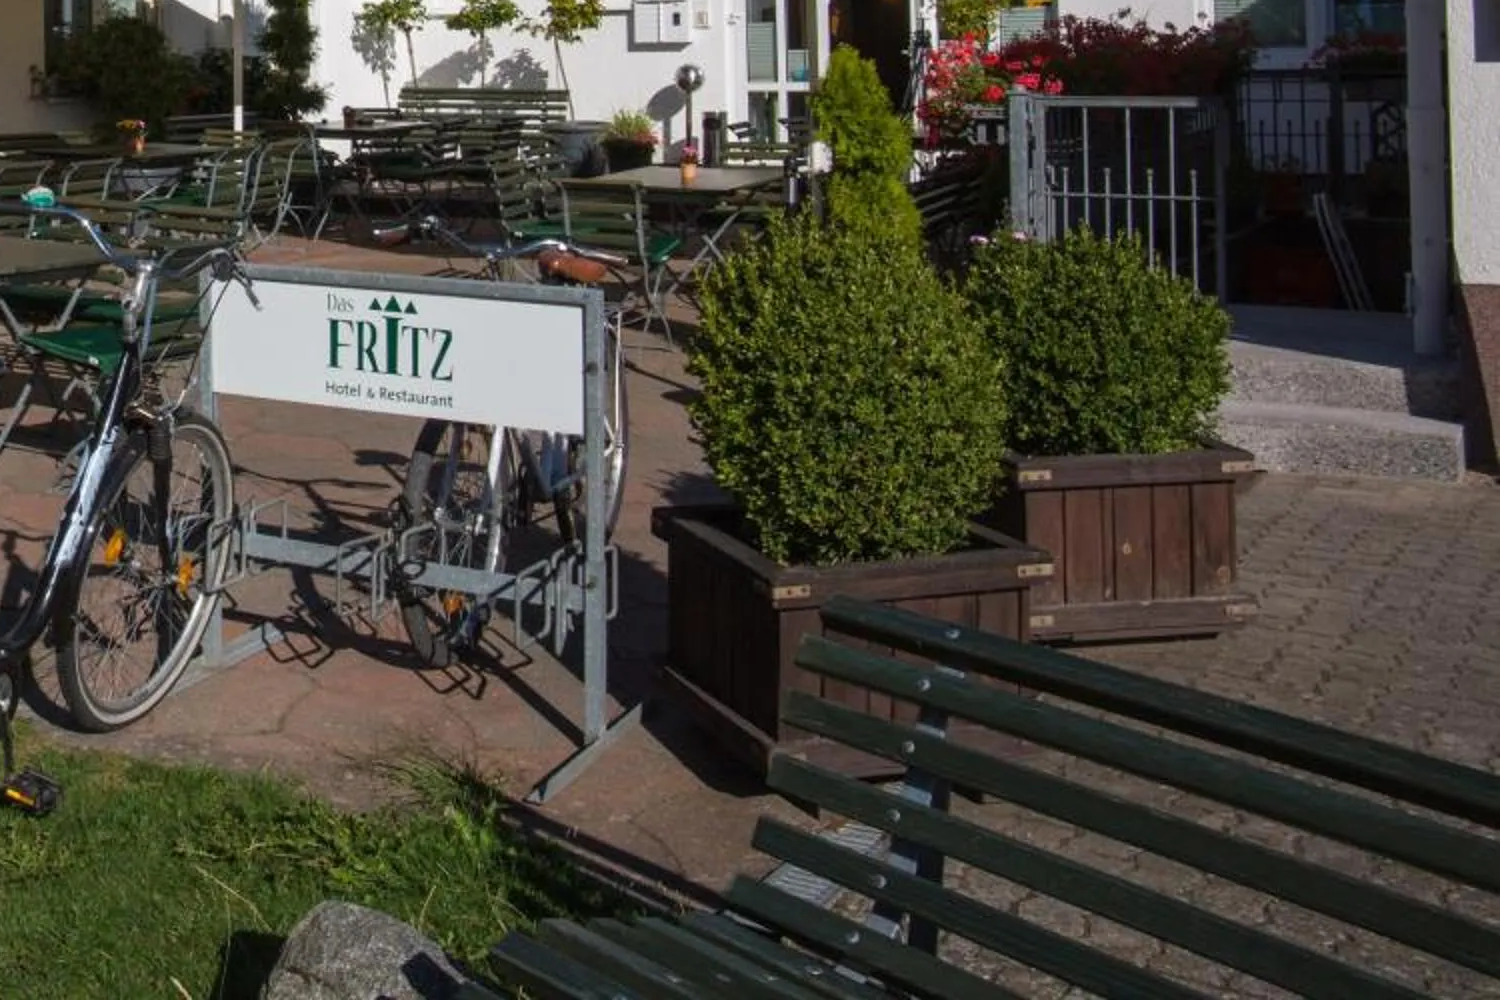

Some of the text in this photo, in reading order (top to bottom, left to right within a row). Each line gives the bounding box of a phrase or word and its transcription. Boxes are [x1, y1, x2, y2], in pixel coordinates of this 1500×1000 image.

[327, 292, 354, 313] Das
[327, 315, 453, 381] FRITZ
[325, 381, 453, 408] Hotel & Restaurant
